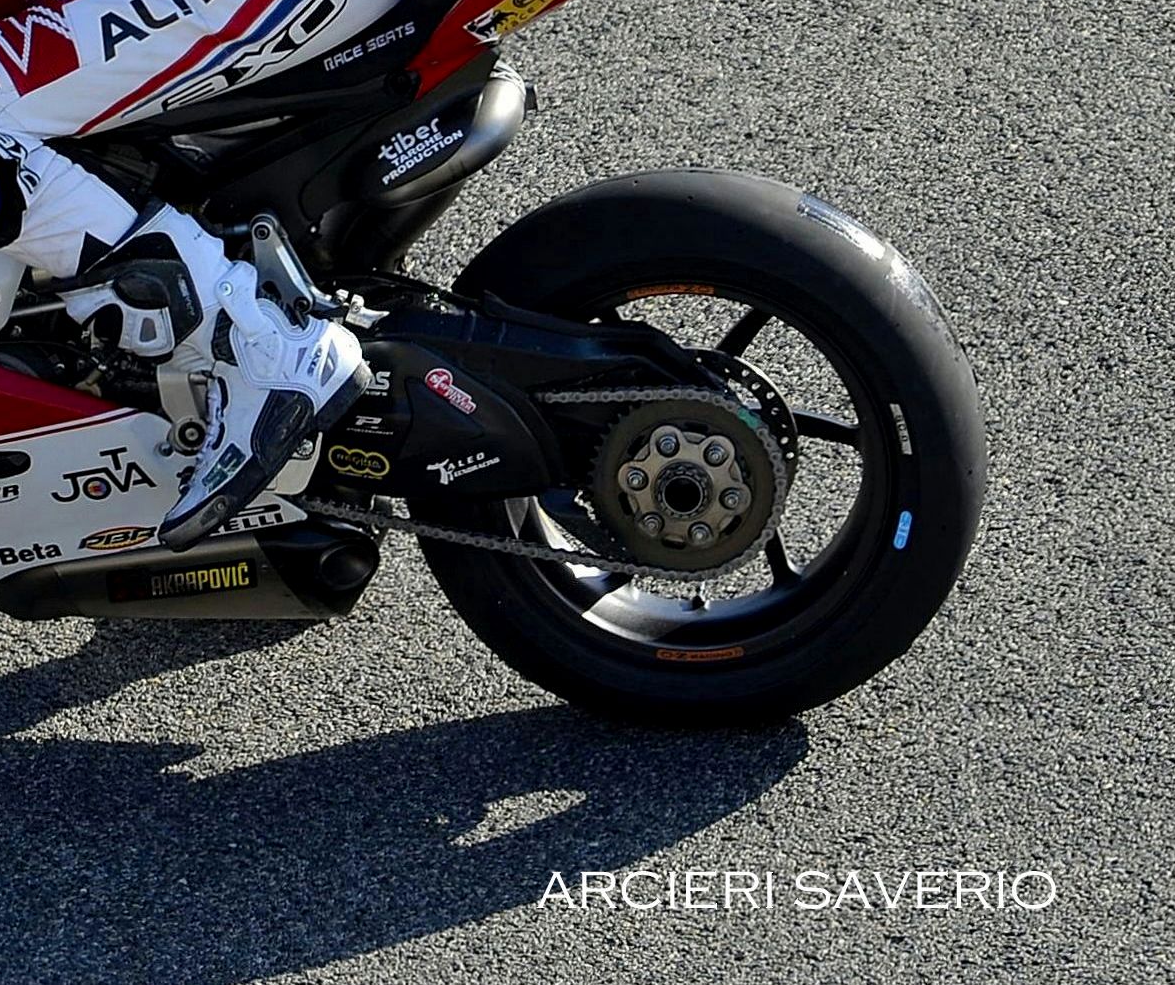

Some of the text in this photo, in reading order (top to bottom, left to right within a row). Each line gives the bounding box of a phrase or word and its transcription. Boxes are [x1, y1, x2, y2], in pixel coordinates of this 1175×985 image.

[324, 21, 417, 72] RACE SEATS
[378, 117, 440, 160] tiber
[382, 129, 465, 185] PRODUCTION
[0, 543, 62, 566] Beta
[78, 526, 158, 550] PBR
